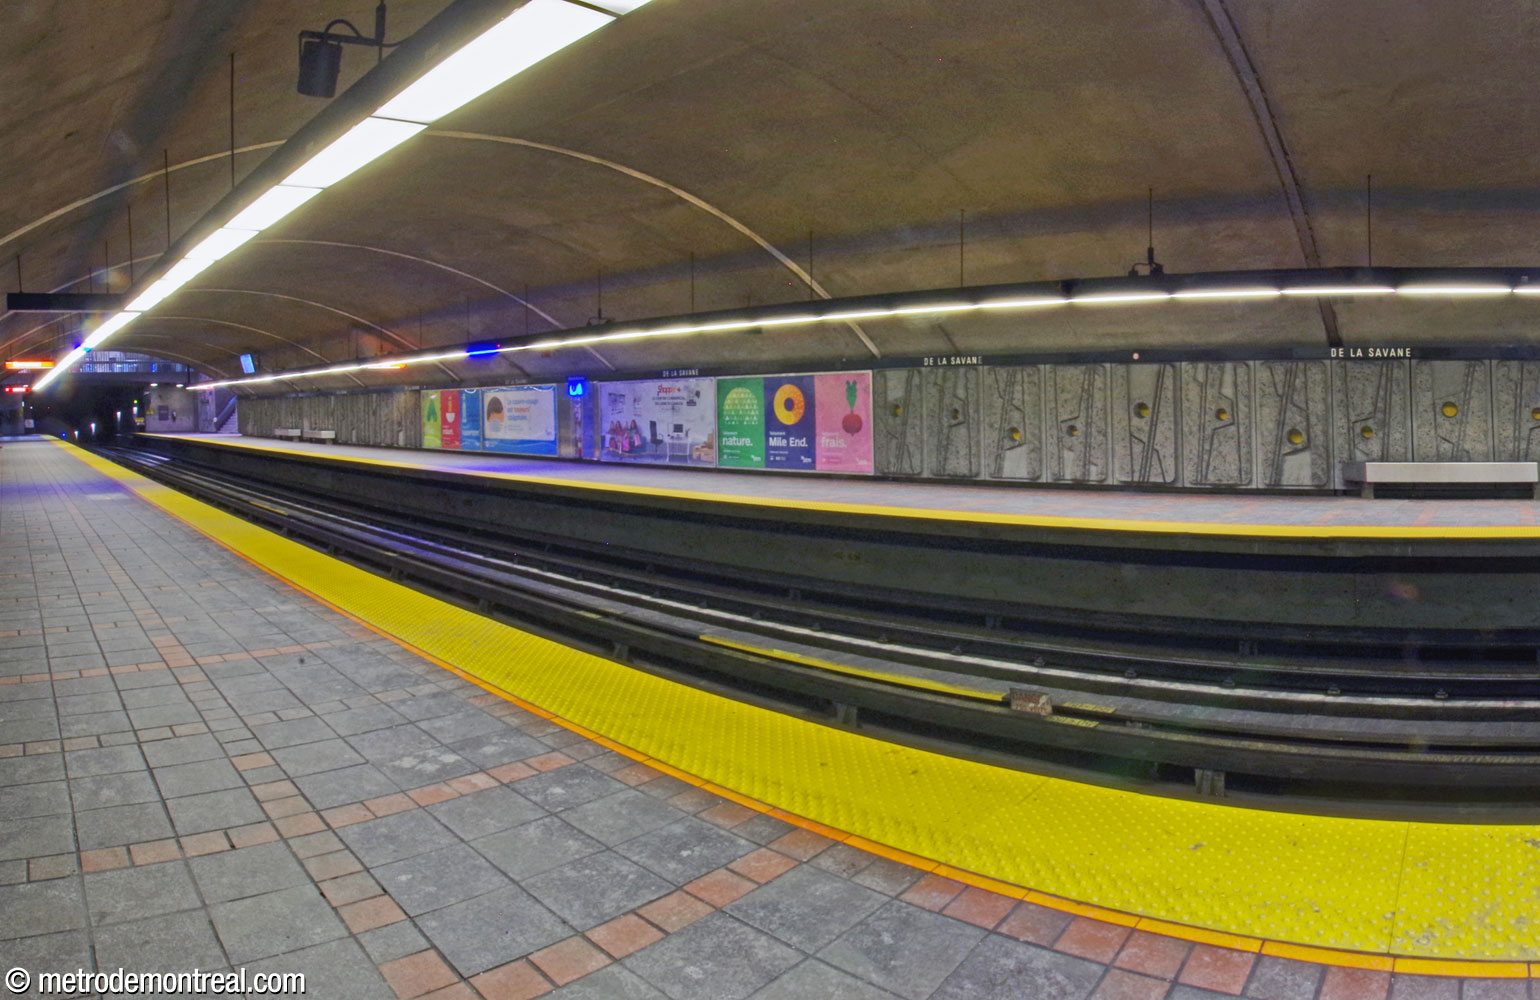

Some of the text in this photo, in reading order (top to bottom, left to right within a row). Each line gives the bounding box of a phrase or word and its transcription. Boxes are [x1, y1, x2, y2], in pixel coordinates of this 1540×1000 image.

[1330, 347, 1412, 358] DE LA SAVANE
[923, 356, 983, 366] DE LA SAVANE
[722, 436, 753, 446] nature.
[769, 437, 808, 447] Mile End.
[821, 436, 848, 448] frais.
